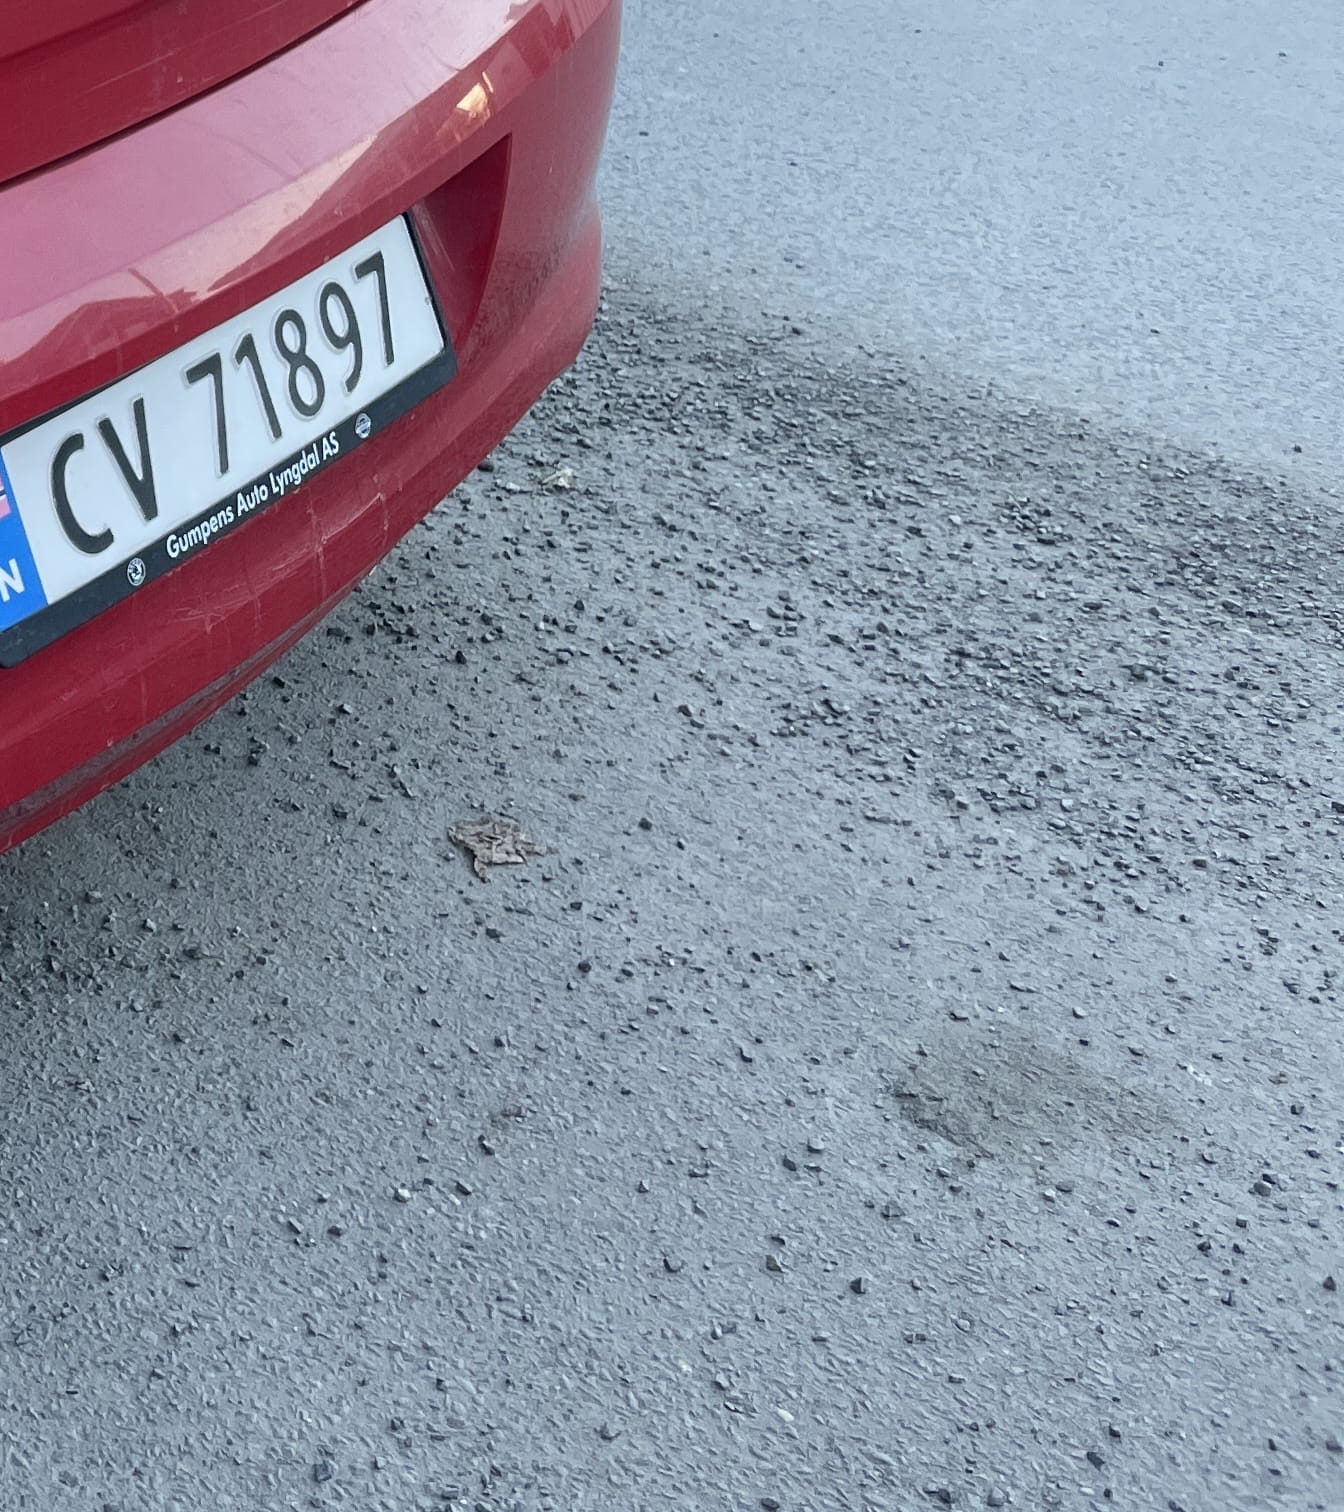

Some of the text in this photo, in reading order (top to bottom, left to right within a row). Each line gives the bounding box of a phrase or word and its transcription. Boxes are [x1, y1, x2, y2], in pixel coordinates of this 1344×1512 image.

[50, 249, 396, 555] CV 71897
[165, 431, 340, 559] Gumpens Auto Lyngdal AS
